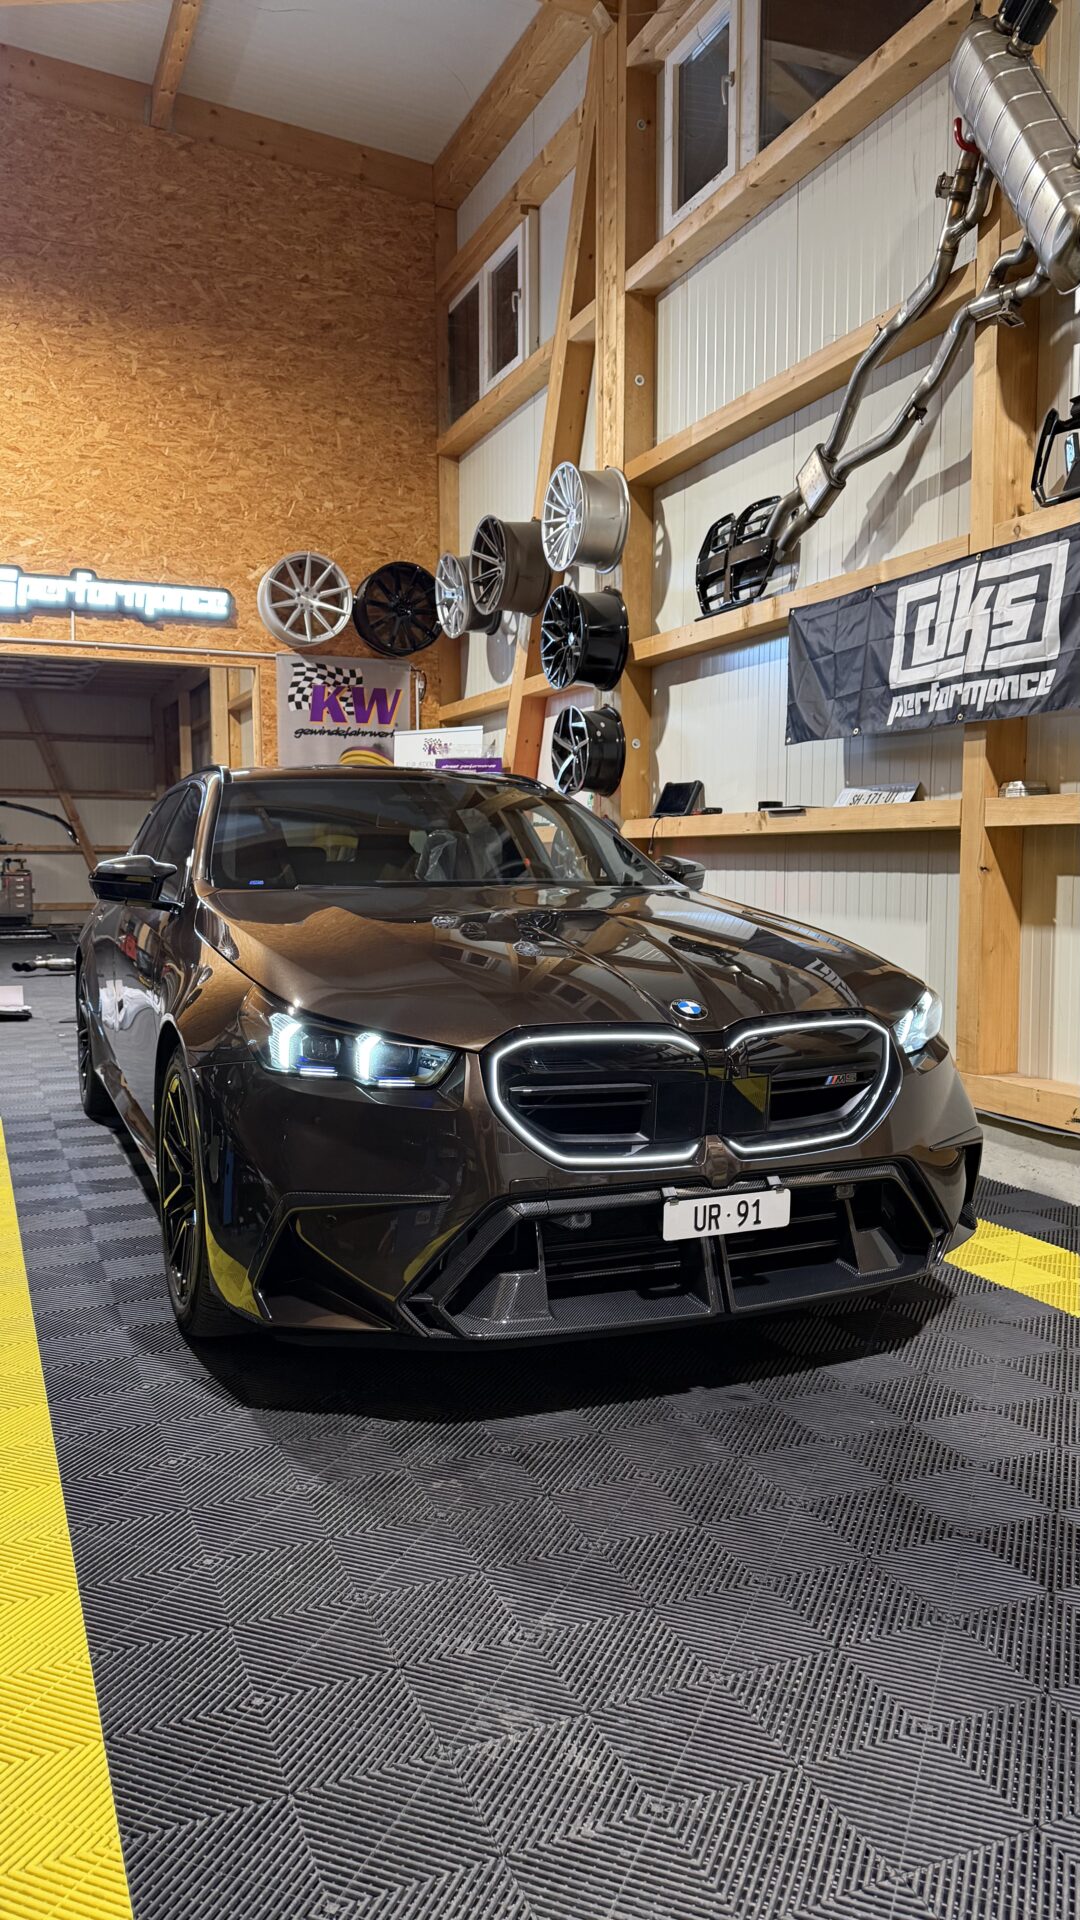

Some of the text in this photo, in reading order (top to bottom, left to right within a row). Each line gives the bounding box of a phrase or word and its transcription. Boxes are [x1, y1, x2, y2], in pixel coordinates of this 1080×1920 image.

[17, 572, 229, 616] performance
[309, 684, 403, 727] KW
[886, 668, 1057, 727] performance
